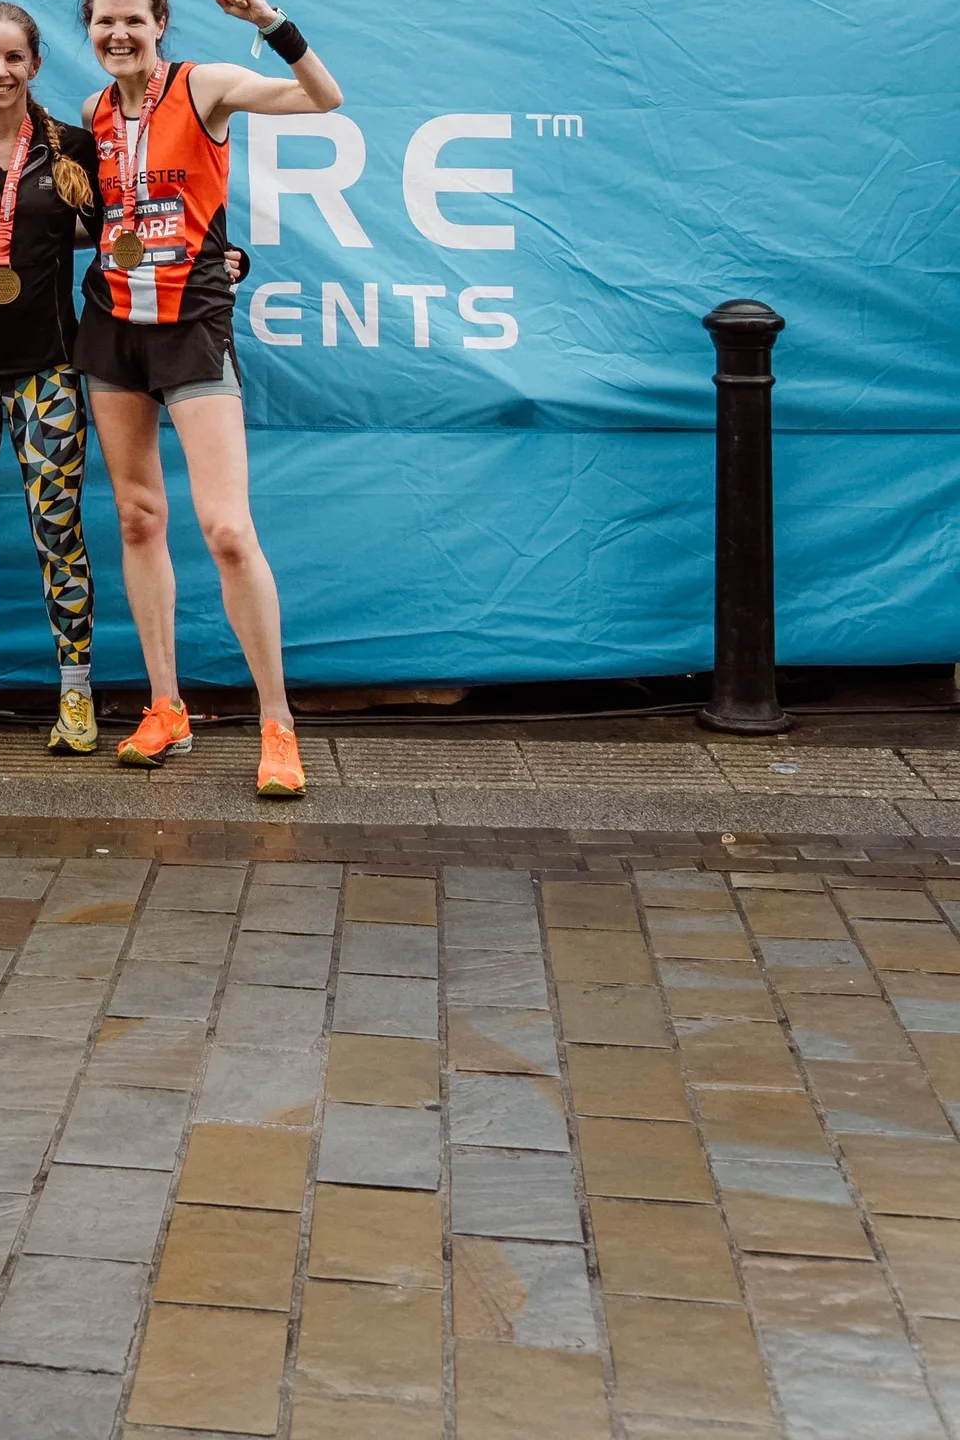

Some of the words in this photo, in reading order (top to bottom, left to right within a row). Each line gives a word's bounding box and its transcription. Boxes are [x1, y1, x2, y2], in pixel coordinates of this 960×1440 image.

[100, 169, 187, 192] CIREESTER
[160, 201, 178, 212] 10K
[108, 216, 179, 242] CARE
[230, 282, 519, 350] ENTS
